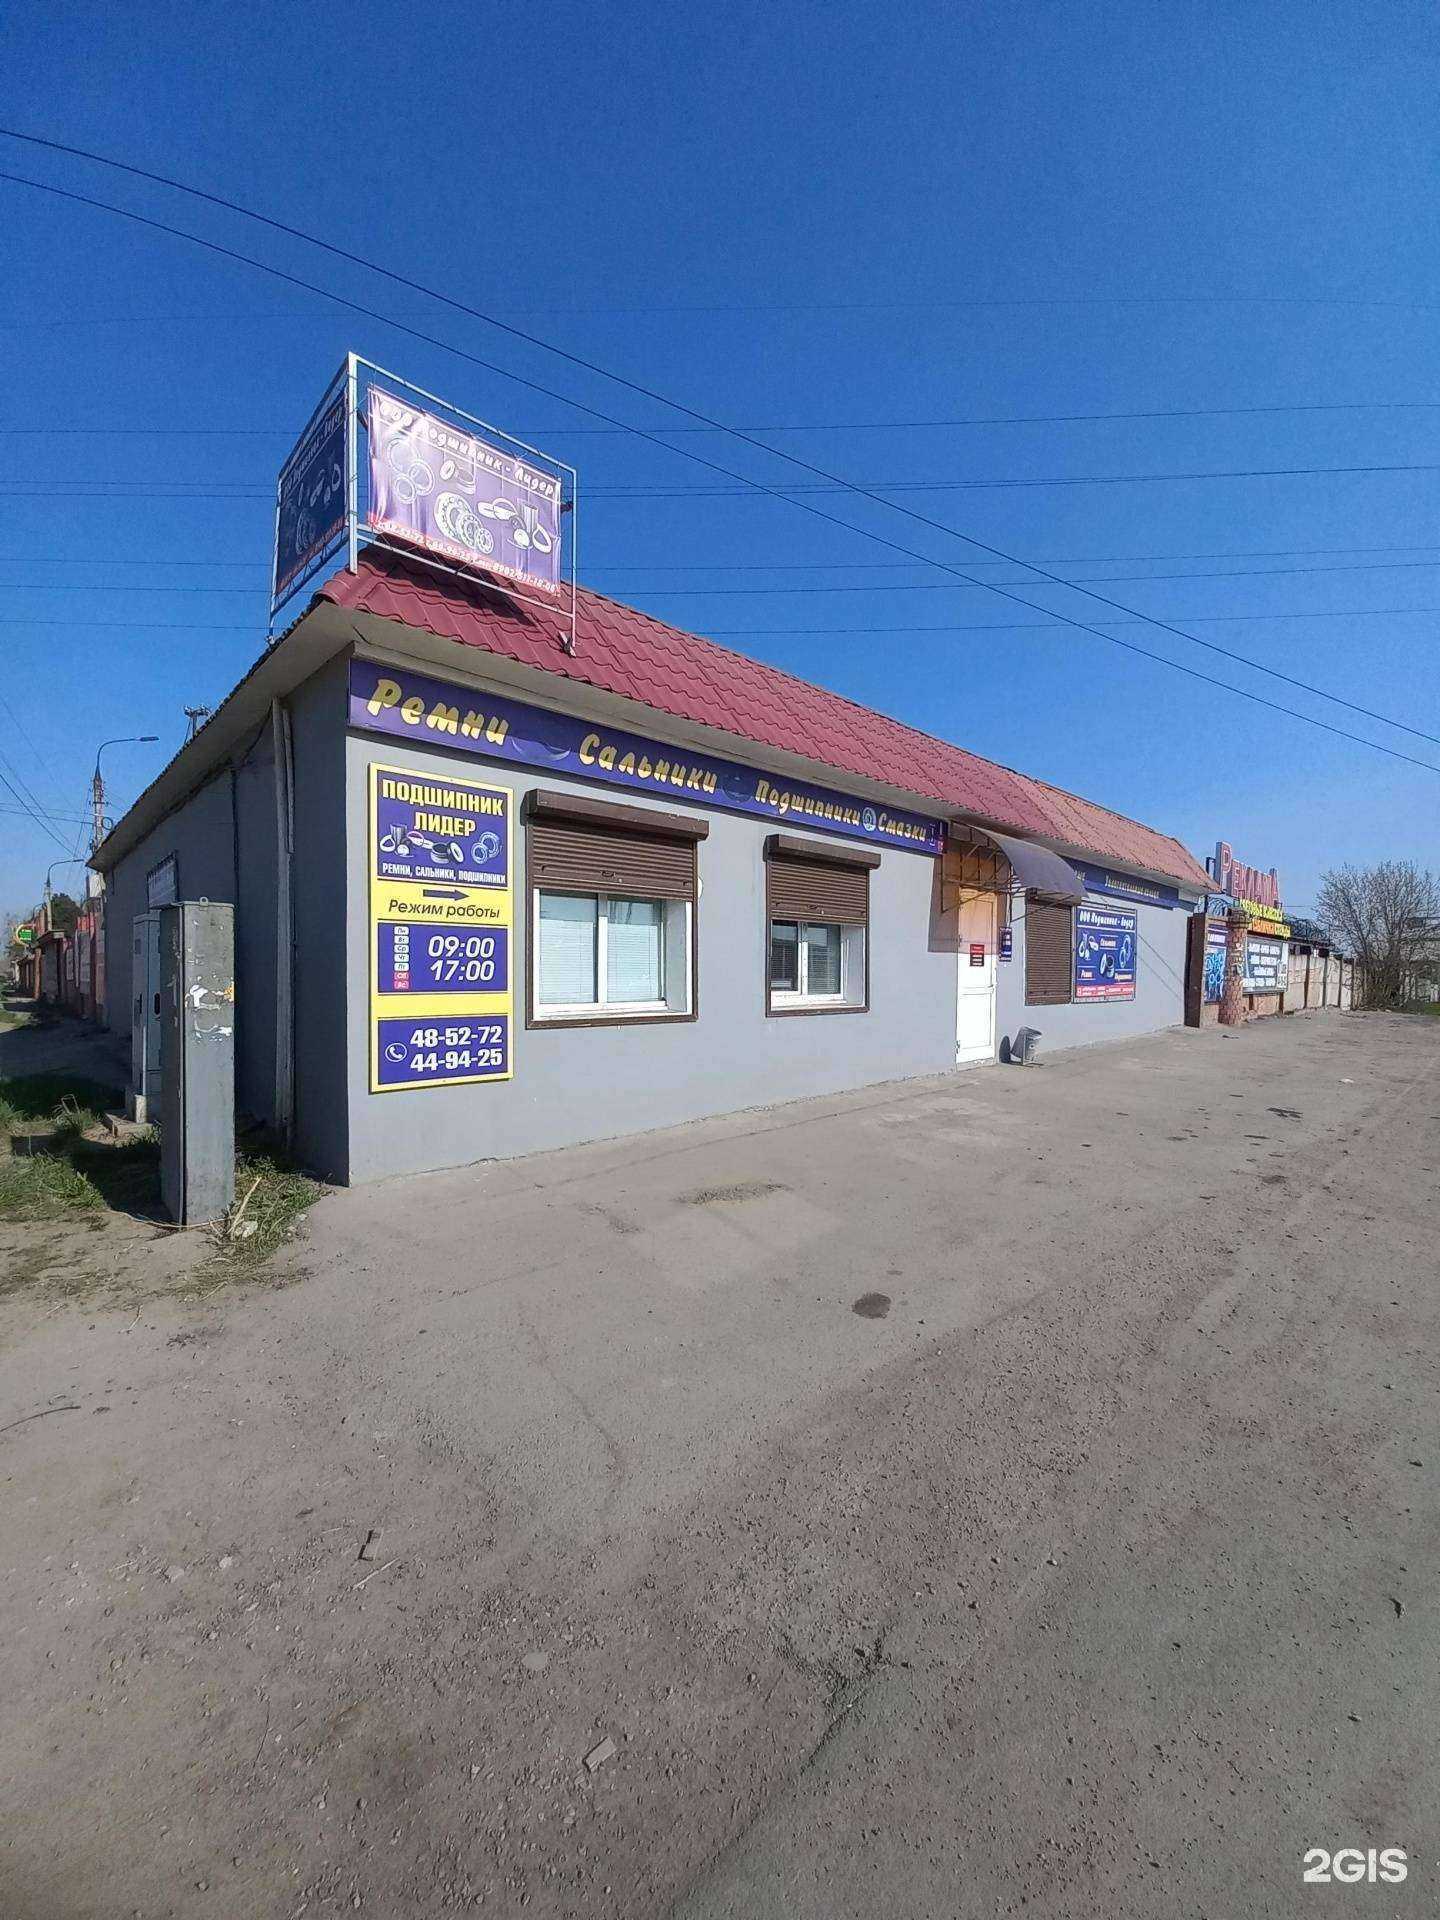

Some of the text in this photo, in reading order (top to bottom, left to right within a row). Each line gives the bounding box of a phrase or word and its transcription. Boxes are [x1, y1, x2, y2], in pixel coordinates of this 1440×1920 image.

[513, 462, 554, 497] Лидер
[366, 678, 927, 842] Ремни Сальники Подшипники Смазки
[382, 779, 504, 816] ПОДШИПНИК
[413, 811, 476, 837] ЛИДЕР
[382, 863, 506, 884] РЕМНИ, САЛЬНИКИ, ПОДШИПНИКИ
[388, 899, 500, 919] Режим работы
[428, 935, 496, 958] 09:00
[430, 959, 496, 982] 17:00
[410, 1025, 503, 1048] 48-52-72
[410, 1048, 503, 1072] 44-94-25
